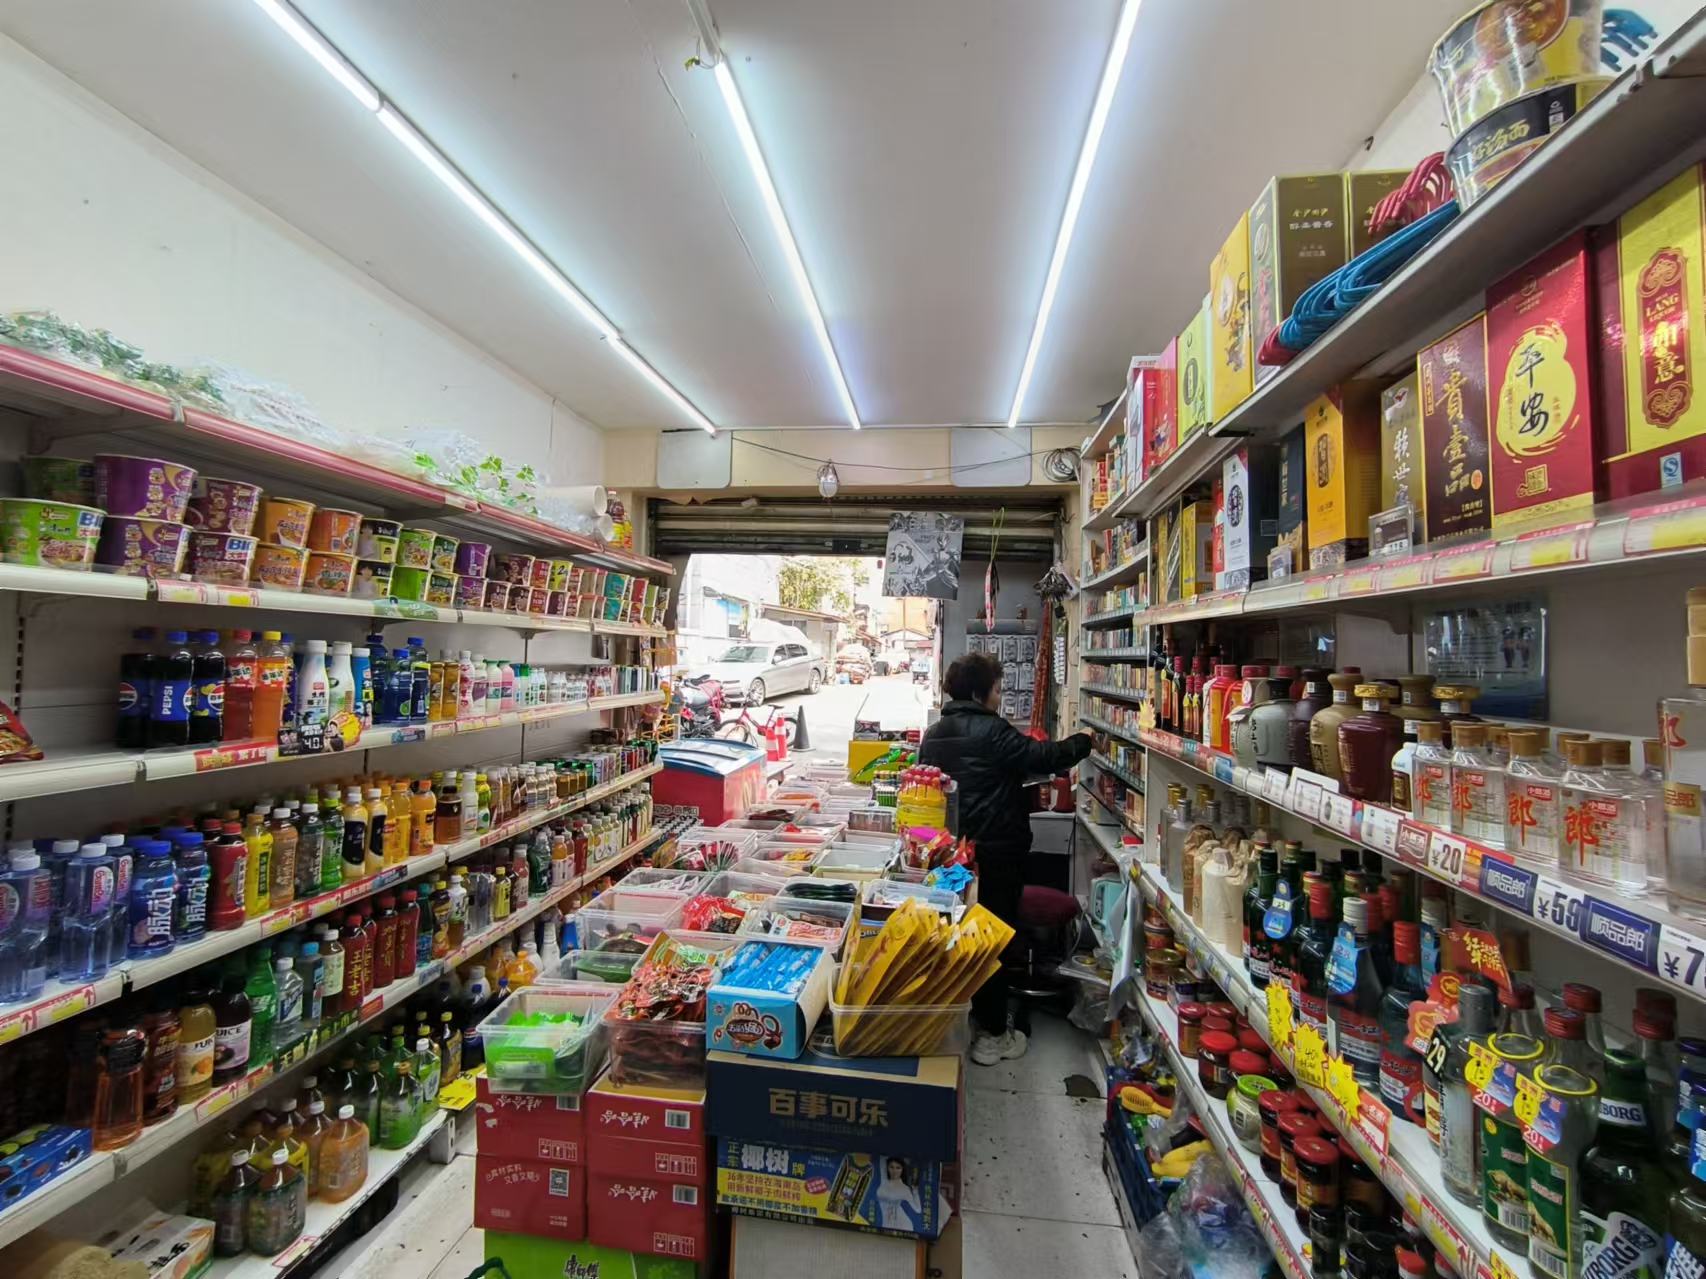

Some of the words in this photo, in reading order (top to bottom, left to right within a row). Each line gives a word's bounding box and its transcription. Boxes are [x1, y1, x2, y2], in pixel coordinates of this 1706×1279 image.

[1645, 294, 1679, 317] LANG
[162, 686, 173, 715] PEPSI
[1508, 793, 1537, 846] 郎
[1564, 804, 1599, 866] 郎
[186, 876, 209, 923] 脉动
[1486, 868, 1527, 898] 顺品郎
[148, 886, 175, 936] 脉动
[1590, 911, 1646, 952] 顺品郎
[348, 949, 363, 996] 王老吉
[1664, 944, 1706, 986] ¥7
[1427, 1037, 1447, 1073] 29
[768, 1087, 888, 1128] 百事可乐
[741, 1144, 790, 1175] 椰树
